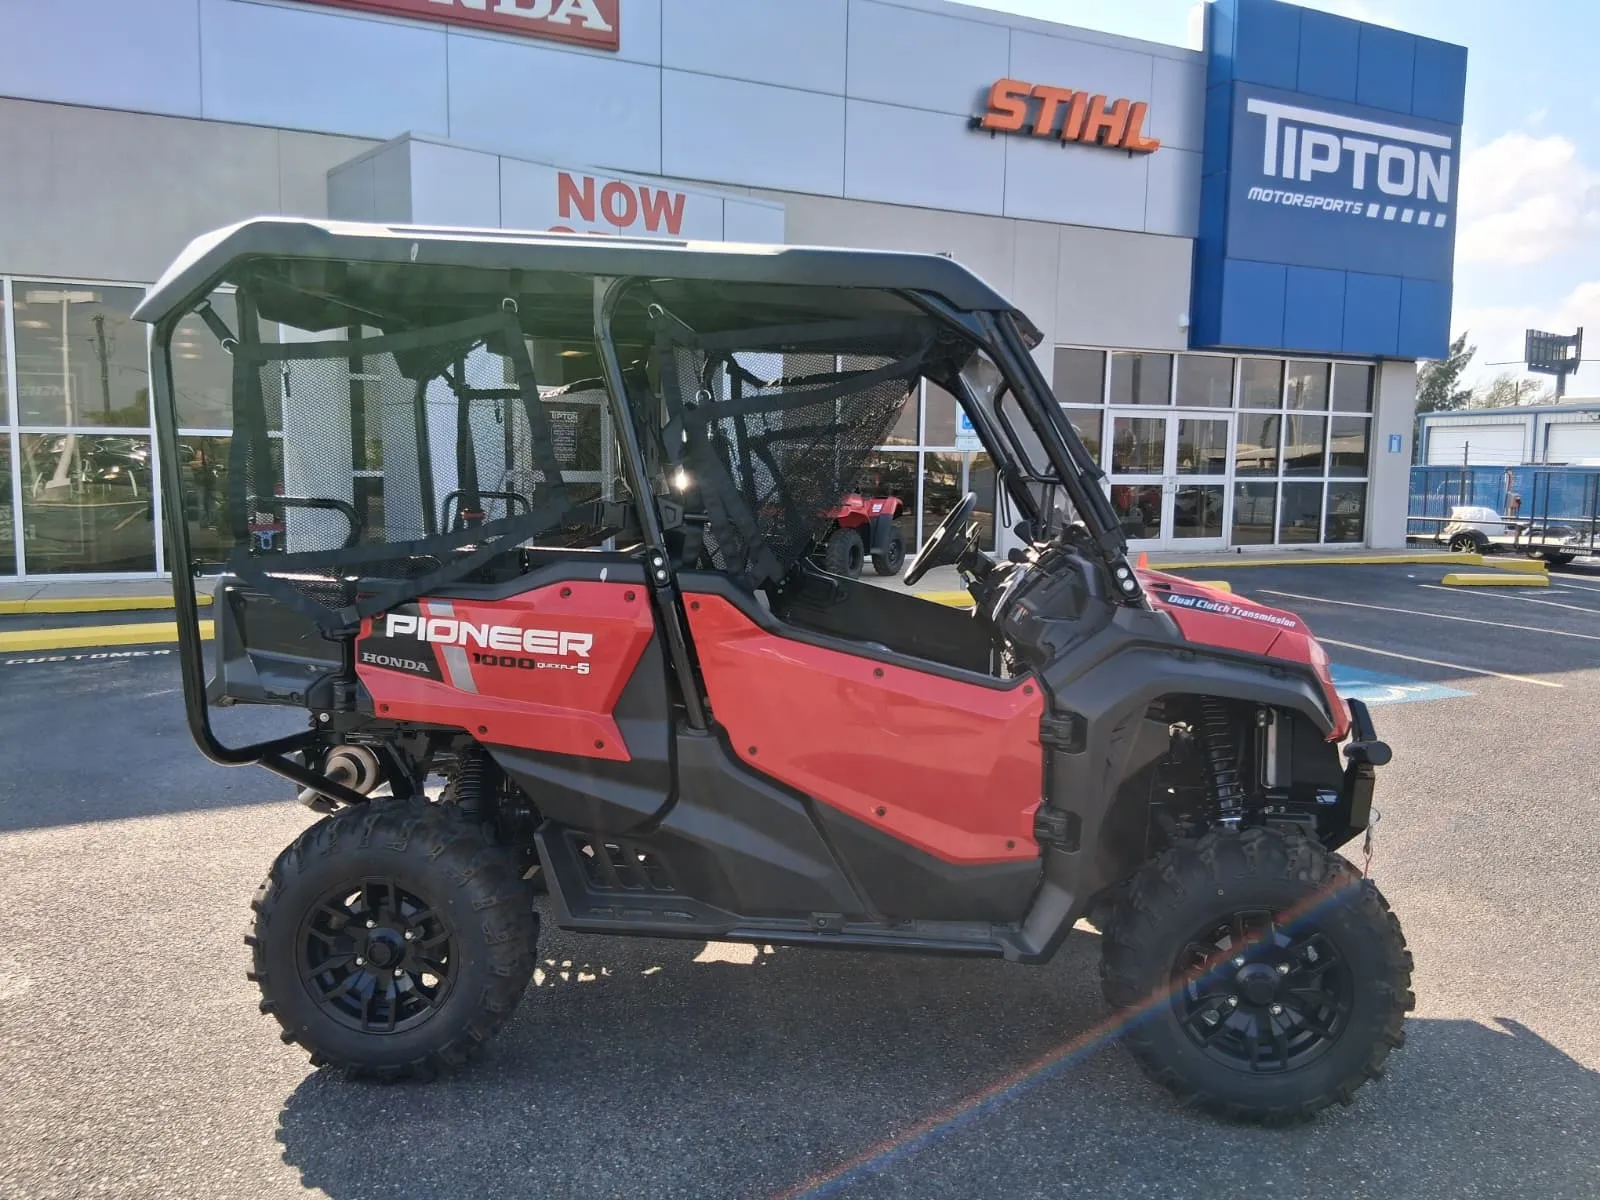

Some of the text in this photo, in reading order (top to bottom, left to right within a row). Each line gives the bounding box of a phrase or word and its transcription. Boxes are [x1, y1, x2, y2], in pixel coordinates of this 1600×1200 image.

[982, 78, 1161, 153] STIHL
[1247, 98, 1452, 203] TIPTON
[558, 171, 686, 235] NOW
[1247, 187, 1364, 215] MOTORSPORTS
[1168, 594, 1197, 606] Dual
[1196, 600, 1230, 613] Clutch
[1230, 606, 1297, 627] Transmission
[385, 613, 593, 657] PIONEER
[5, 650, 171, 665] CUSTOMER
[362, 652, 430, 673] HONDA
[473, 652, 536, 670] 1000
